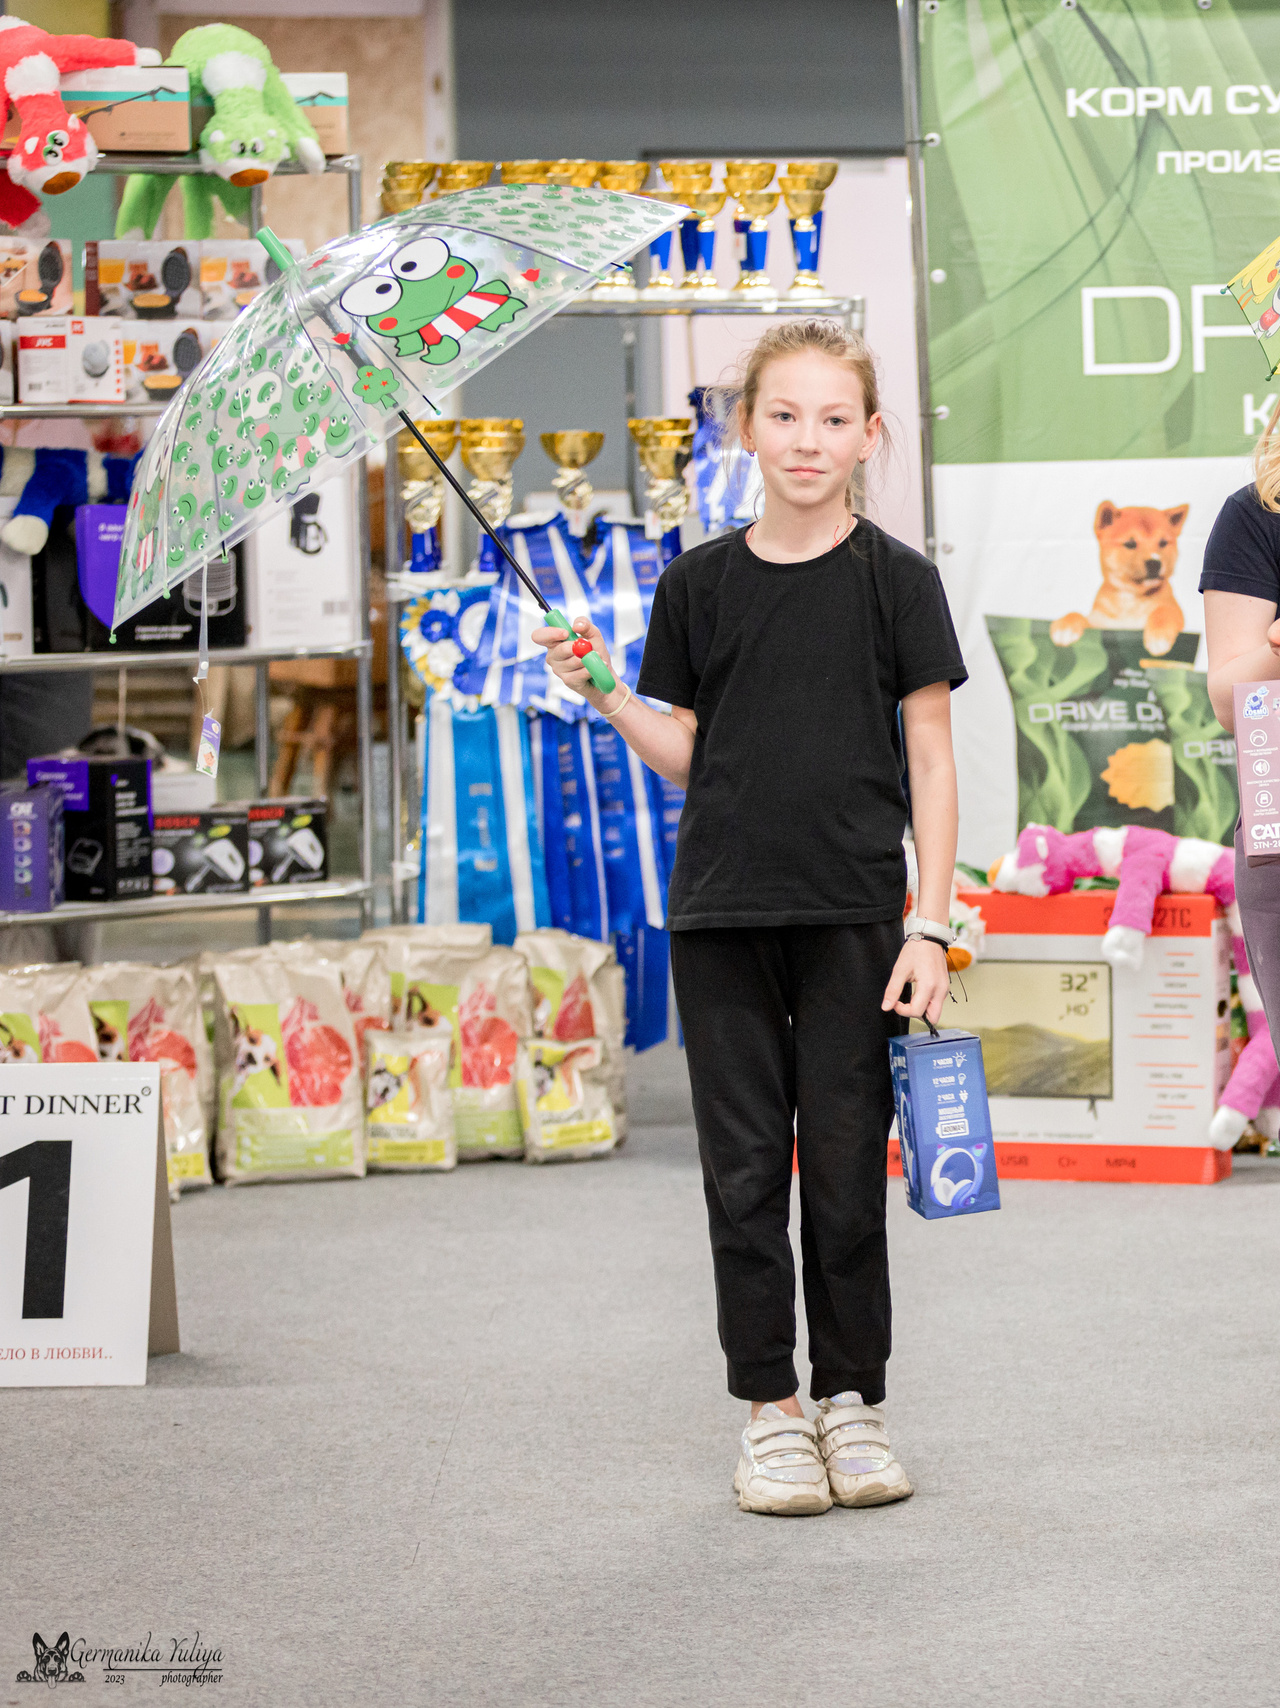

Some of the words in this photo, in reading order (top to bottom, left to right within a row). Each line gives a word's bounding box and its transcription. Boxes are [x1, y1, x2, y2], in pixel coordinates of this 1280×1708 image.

[1065, 85, 1213, 118] КОРМ
[1027, 700, 1129, 724] DRIVE
[0, 1140, 73, 1320] 1
[31, 1348, 40, 1360] В
